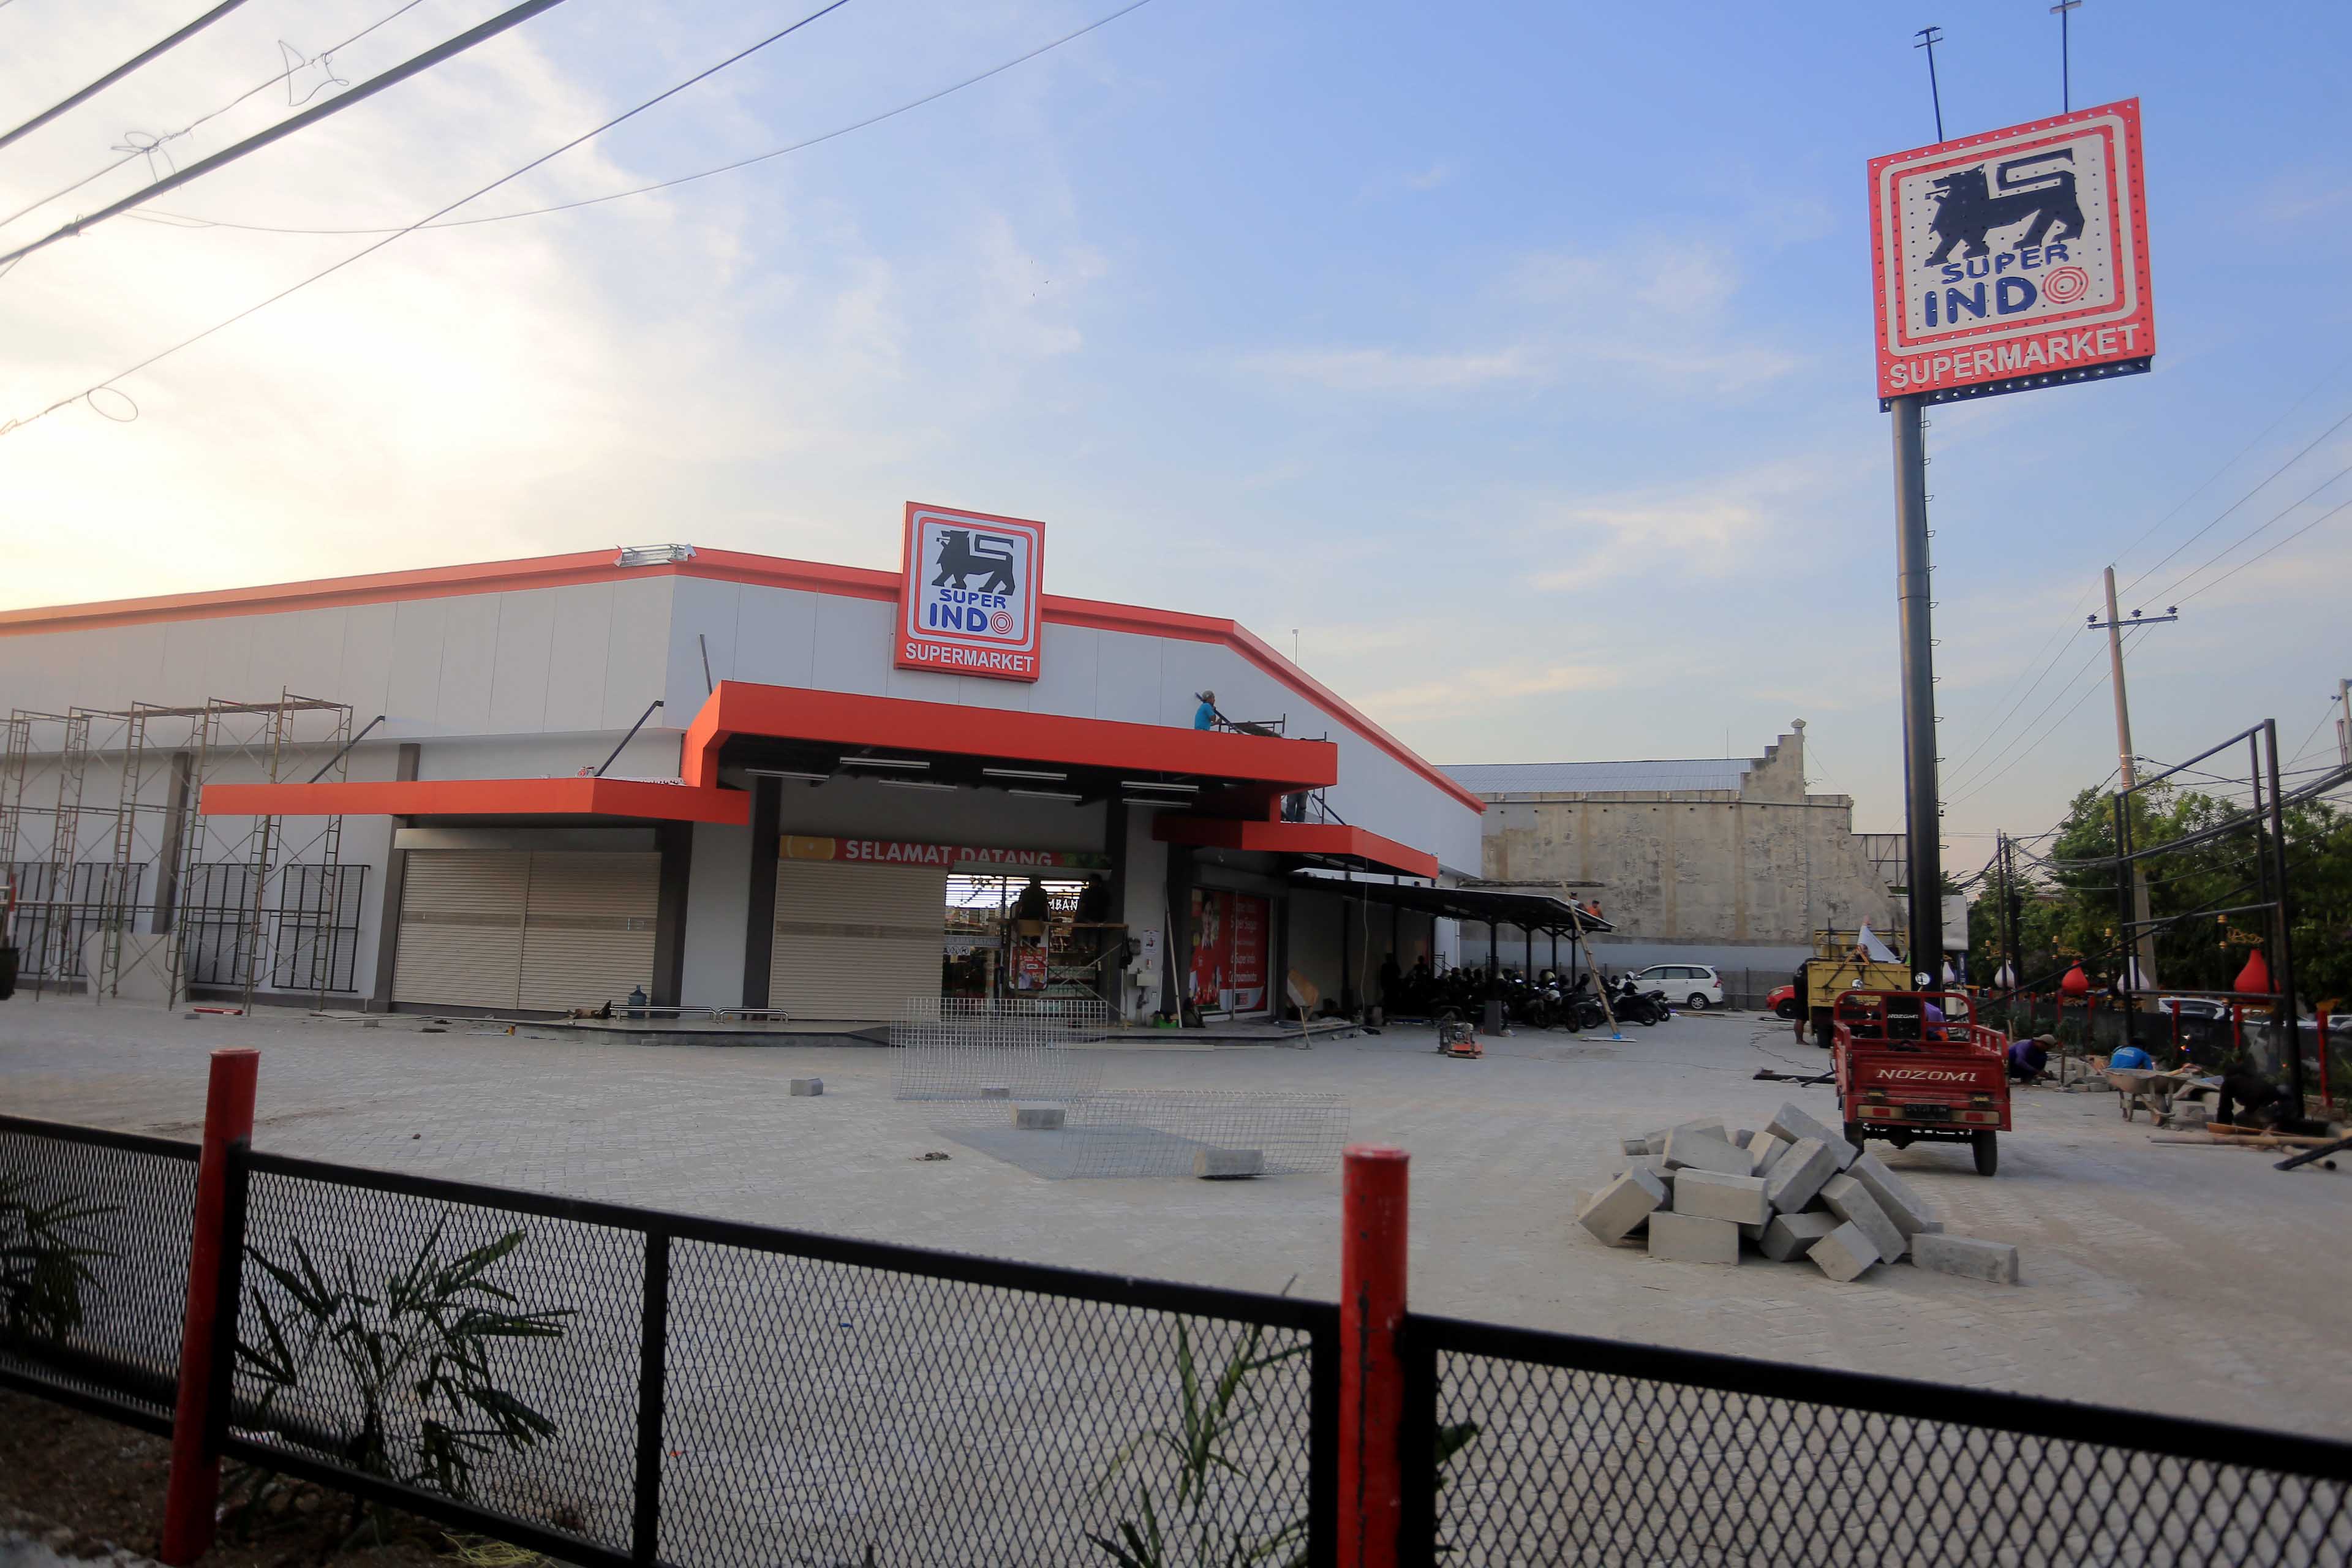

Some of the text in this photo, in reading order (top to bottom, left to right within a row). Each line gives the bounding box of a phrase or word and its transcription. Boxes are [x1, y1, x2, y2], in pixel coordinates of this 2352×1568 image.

[1941, 244, 2069, 285] SUPER
[1924, 266, 2089, 328] INDO
[1890, 323, 2140, 389] SUPERMARKET
[939, 589, 1006, 609] SUPER
[929, 603, 1014, 635] INDO
[905, 643, 1034, 672] SUPERMARKET
[846, 840, 1052, 866] SELAMAT DATANG
[1876, 1069, 1977, 1082] NOZOMI
